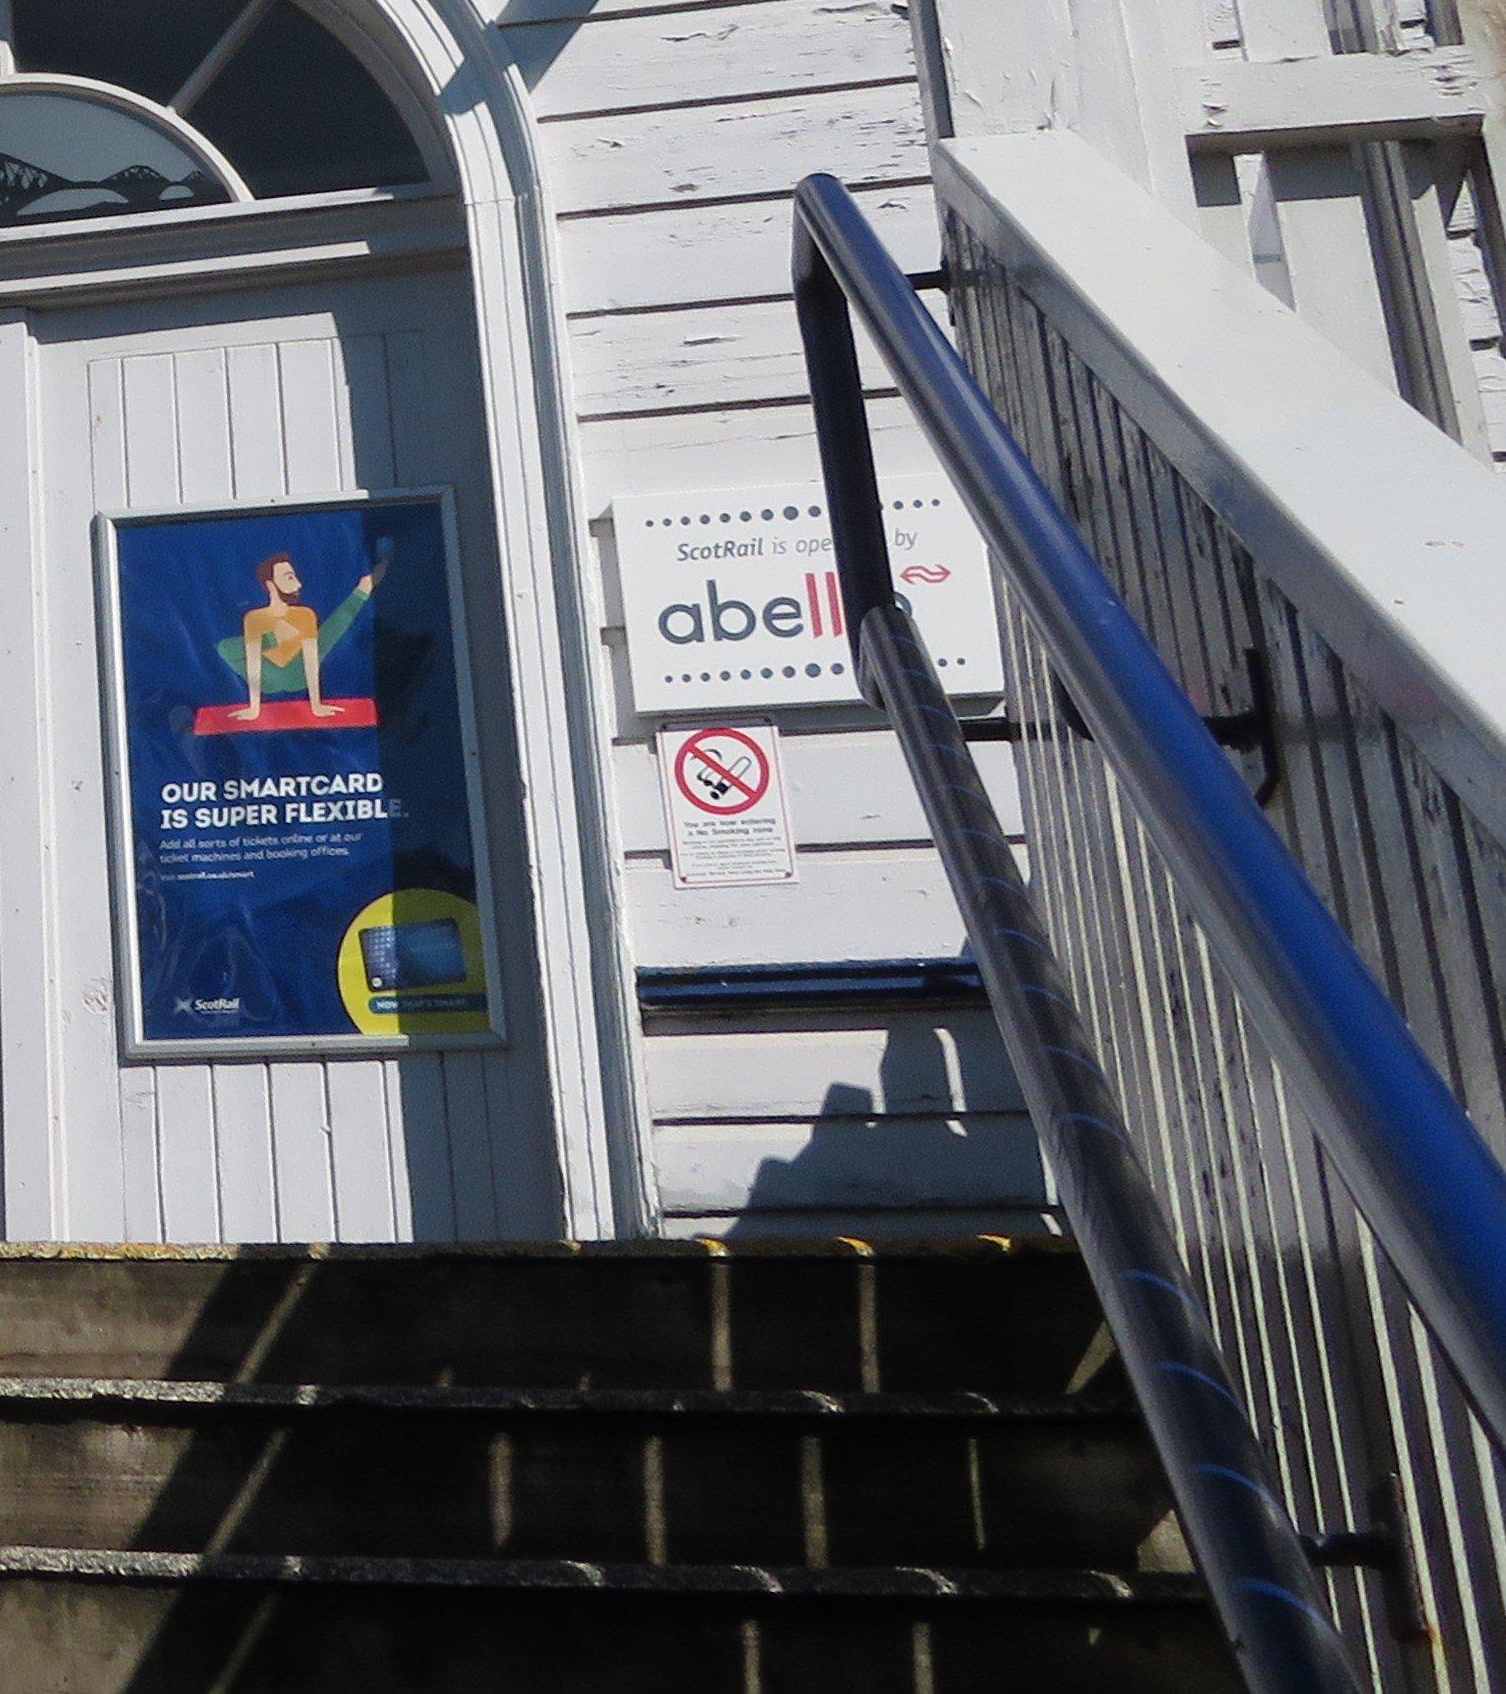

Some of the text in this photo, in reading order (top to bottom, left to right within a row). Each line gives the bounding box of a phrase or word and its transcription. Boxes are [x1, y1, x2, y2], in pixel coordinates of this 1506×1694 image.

[676, 536, 765, 562] ScotRail
[771, 536, 787, 555] is
[893, 527, 919, 549] by
[658, 572, 913, 644] abell
[161, 772, 384, 804] OUR SMARTCARD
[160, 797, 410, 830] IS SUPER FLEXIBLE.
[159, 832, 363, 850] Add all sorts of tickets online or at our
[160, 845, 350, 864] ticket machines and booking offices.
[194, 997, 240, 1012] ScotRail
